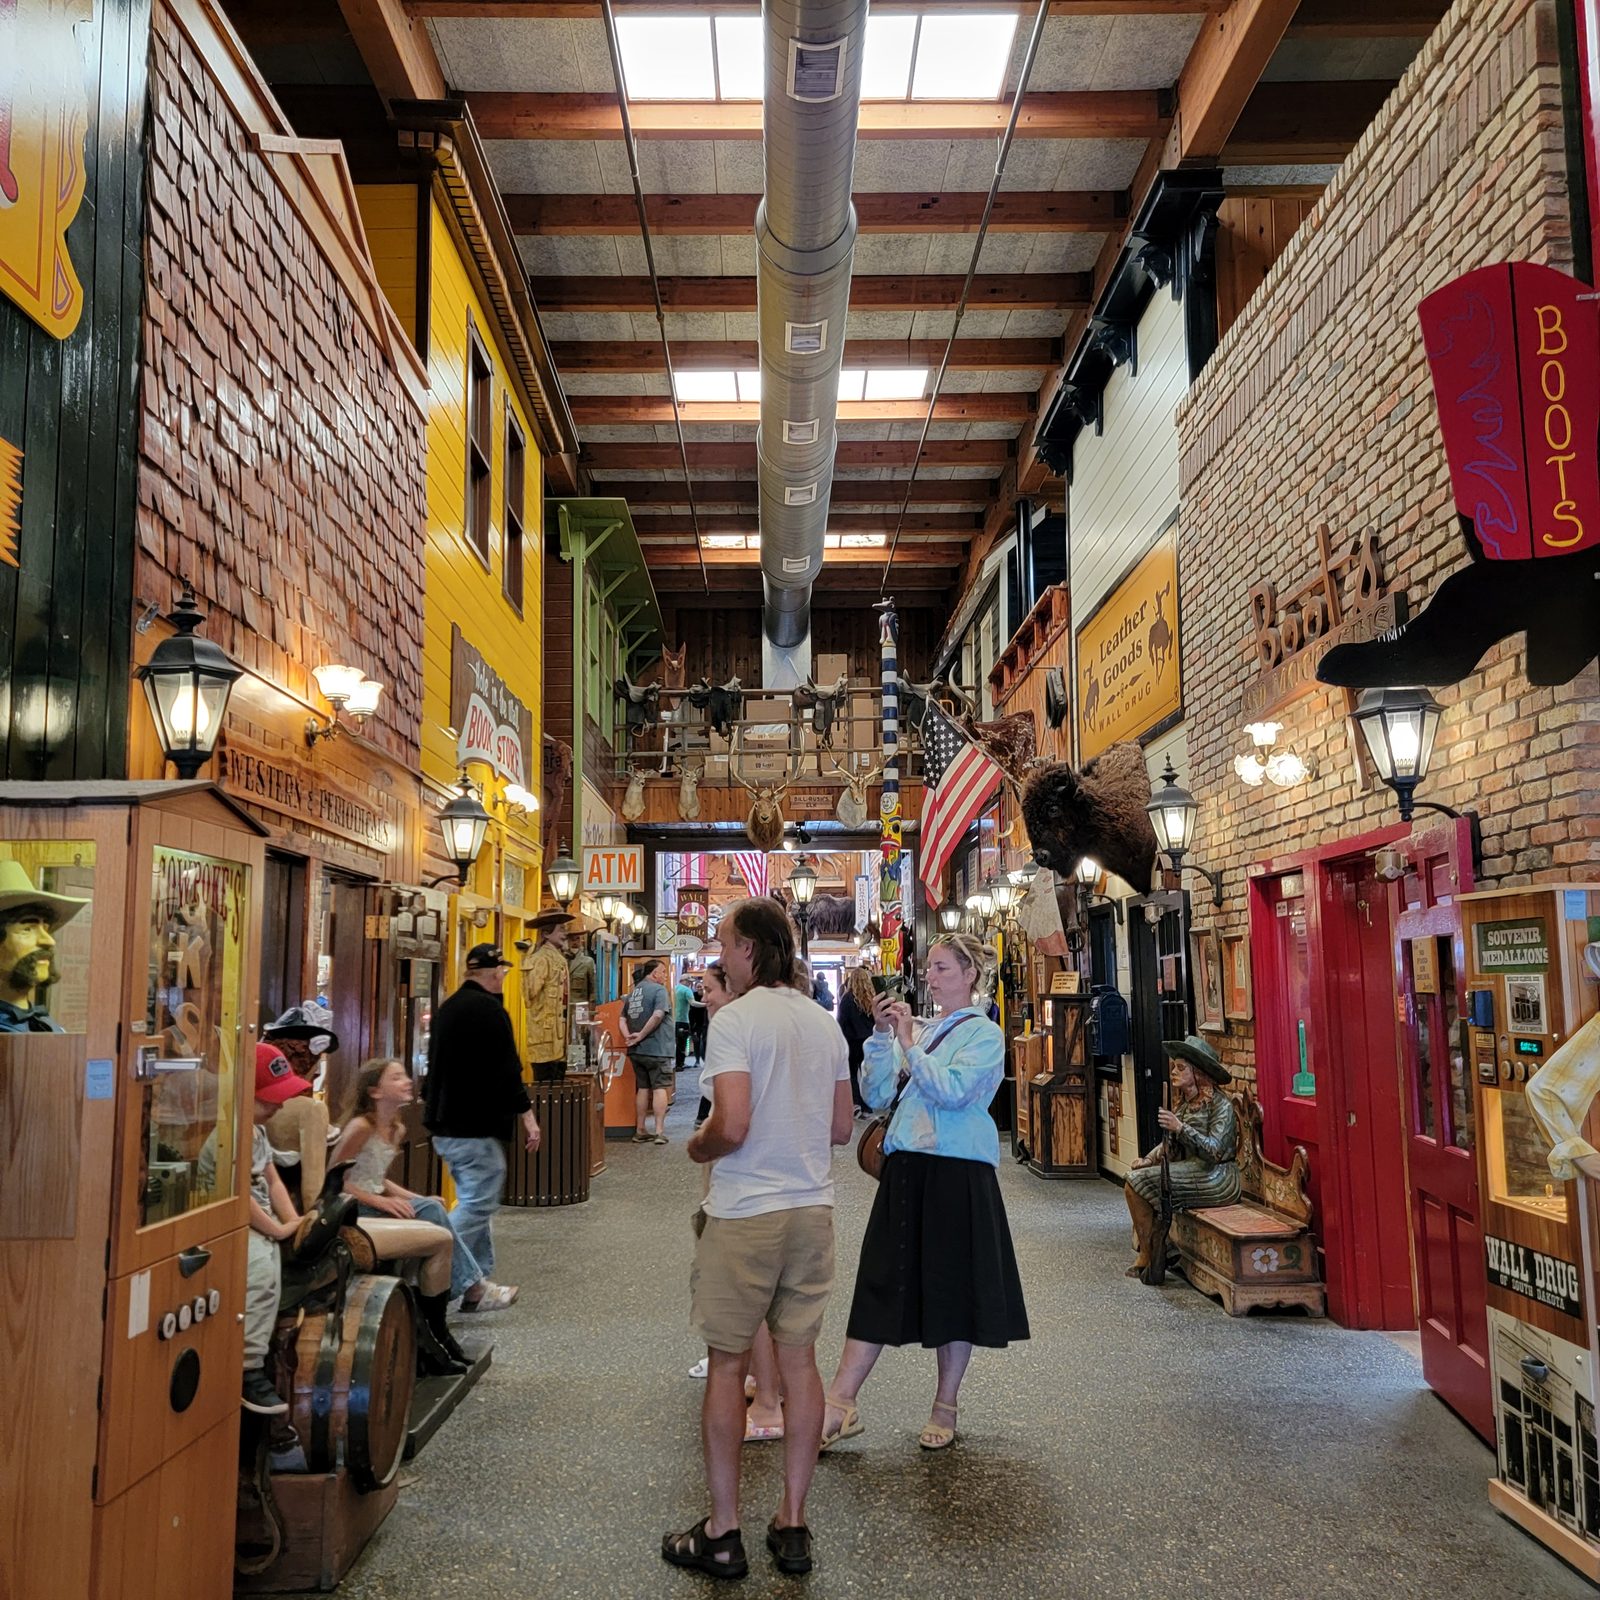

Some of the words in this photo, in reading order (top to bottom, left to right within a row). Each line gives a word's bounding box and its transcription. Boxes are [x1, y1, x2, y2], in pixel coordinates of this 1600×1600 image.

[1534, 304, 1583, 547] BOOTS
[1099, 599, 1148, 664] Leather
[1102, 639, 1143, 689] Goods
[466, 705, 494, 755] BOOK
[1099, 709, 1122, 732] WALL
[1125, 681, 1152, 712] DRUG
[496, 735, 520, 779] STORE
[230, 749, 302, 812] WESTERN
[319, 788, 389, 847] PERIODICALS
[588, 853, 637, 884] ATM
[1482, 947, 1549, 966] MEDALLIONS
[1487, 927, 1541, 946] SOUVENIR
[1485, 1235, 1529, 1283] WALL
[1533, 1252, 1579, 1302] DRUG
[1499, 1274, 1508, 1286] OF
[1511, 1278, 1534, 1297] SOUTH
[1536, 1288, 1566, 1310] DAKOTA
